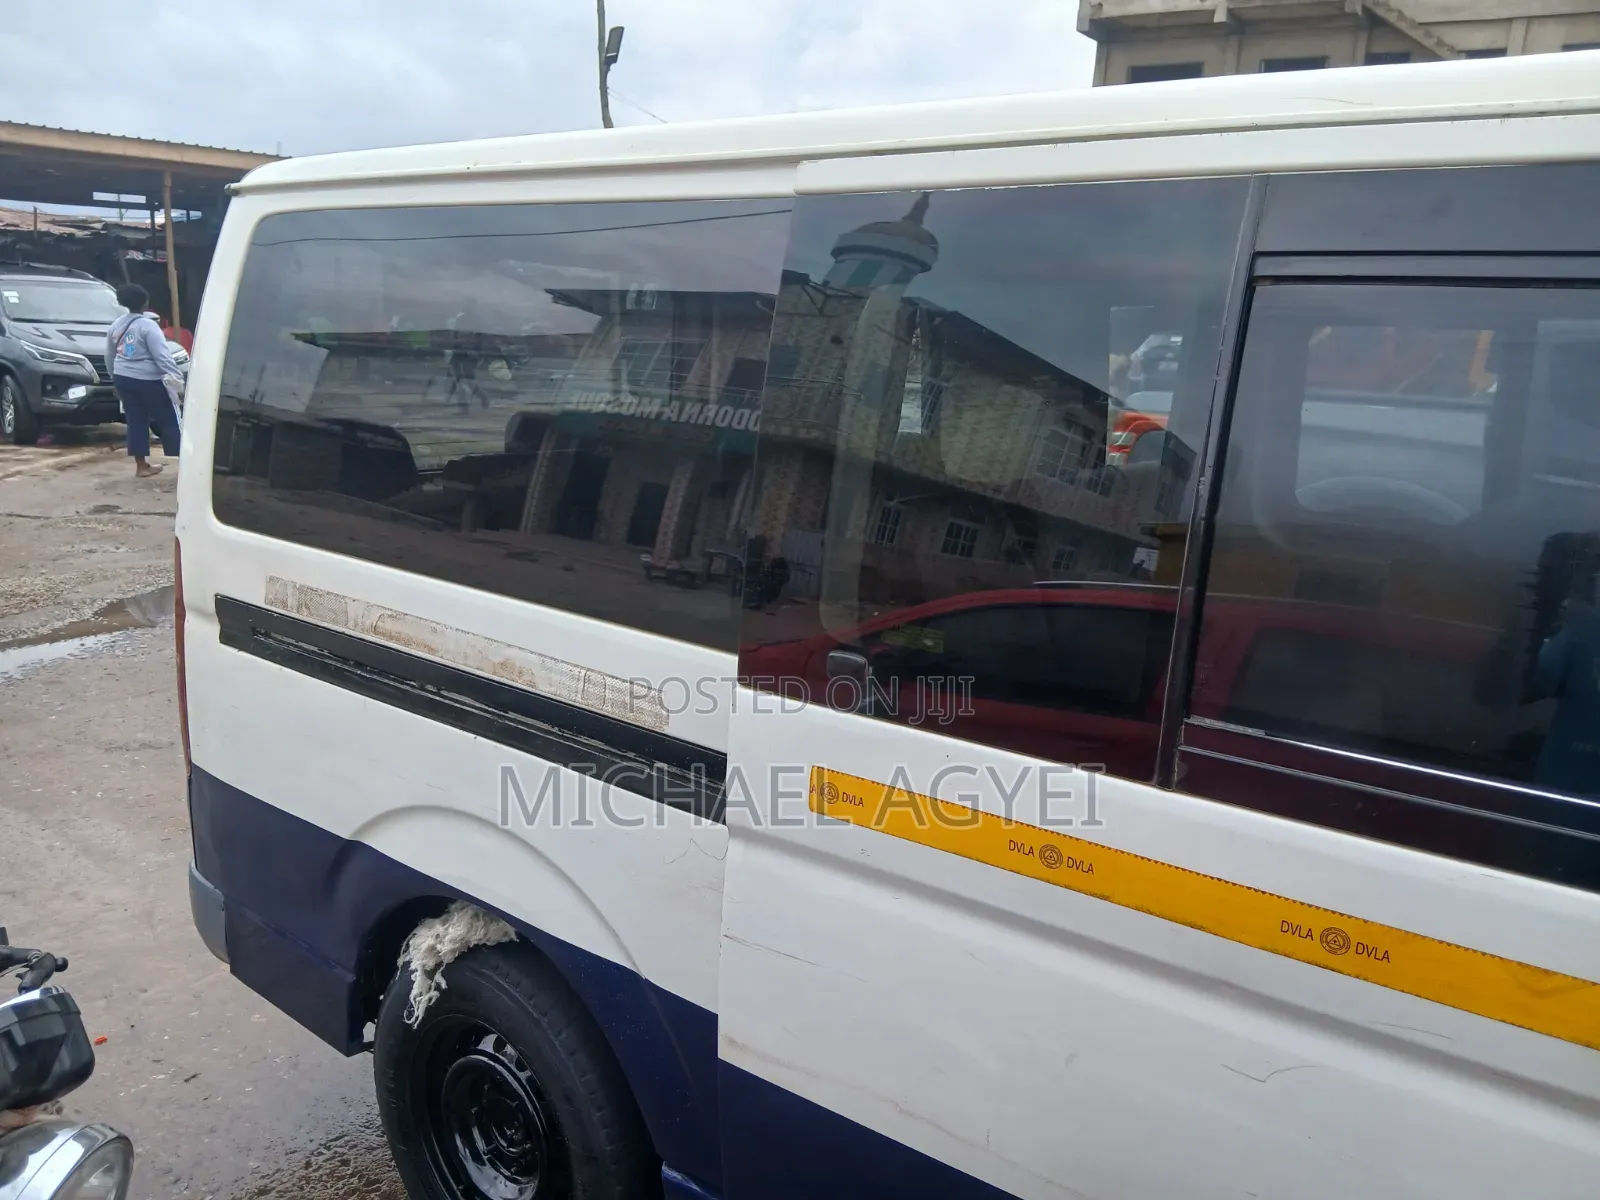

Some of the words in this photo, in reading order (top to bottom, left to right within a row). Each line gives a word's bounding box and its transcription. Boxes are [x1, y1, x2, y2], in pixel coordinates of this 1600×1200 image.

[841, 791, 865, 808] DVLA
[1008, 839, 1035, 857] DVLA
[1066, 856, 1095, 875] DVLA
[1280, 919, 1314, 941] DVLA
[1355, 941, 1391, 963] DVLA
